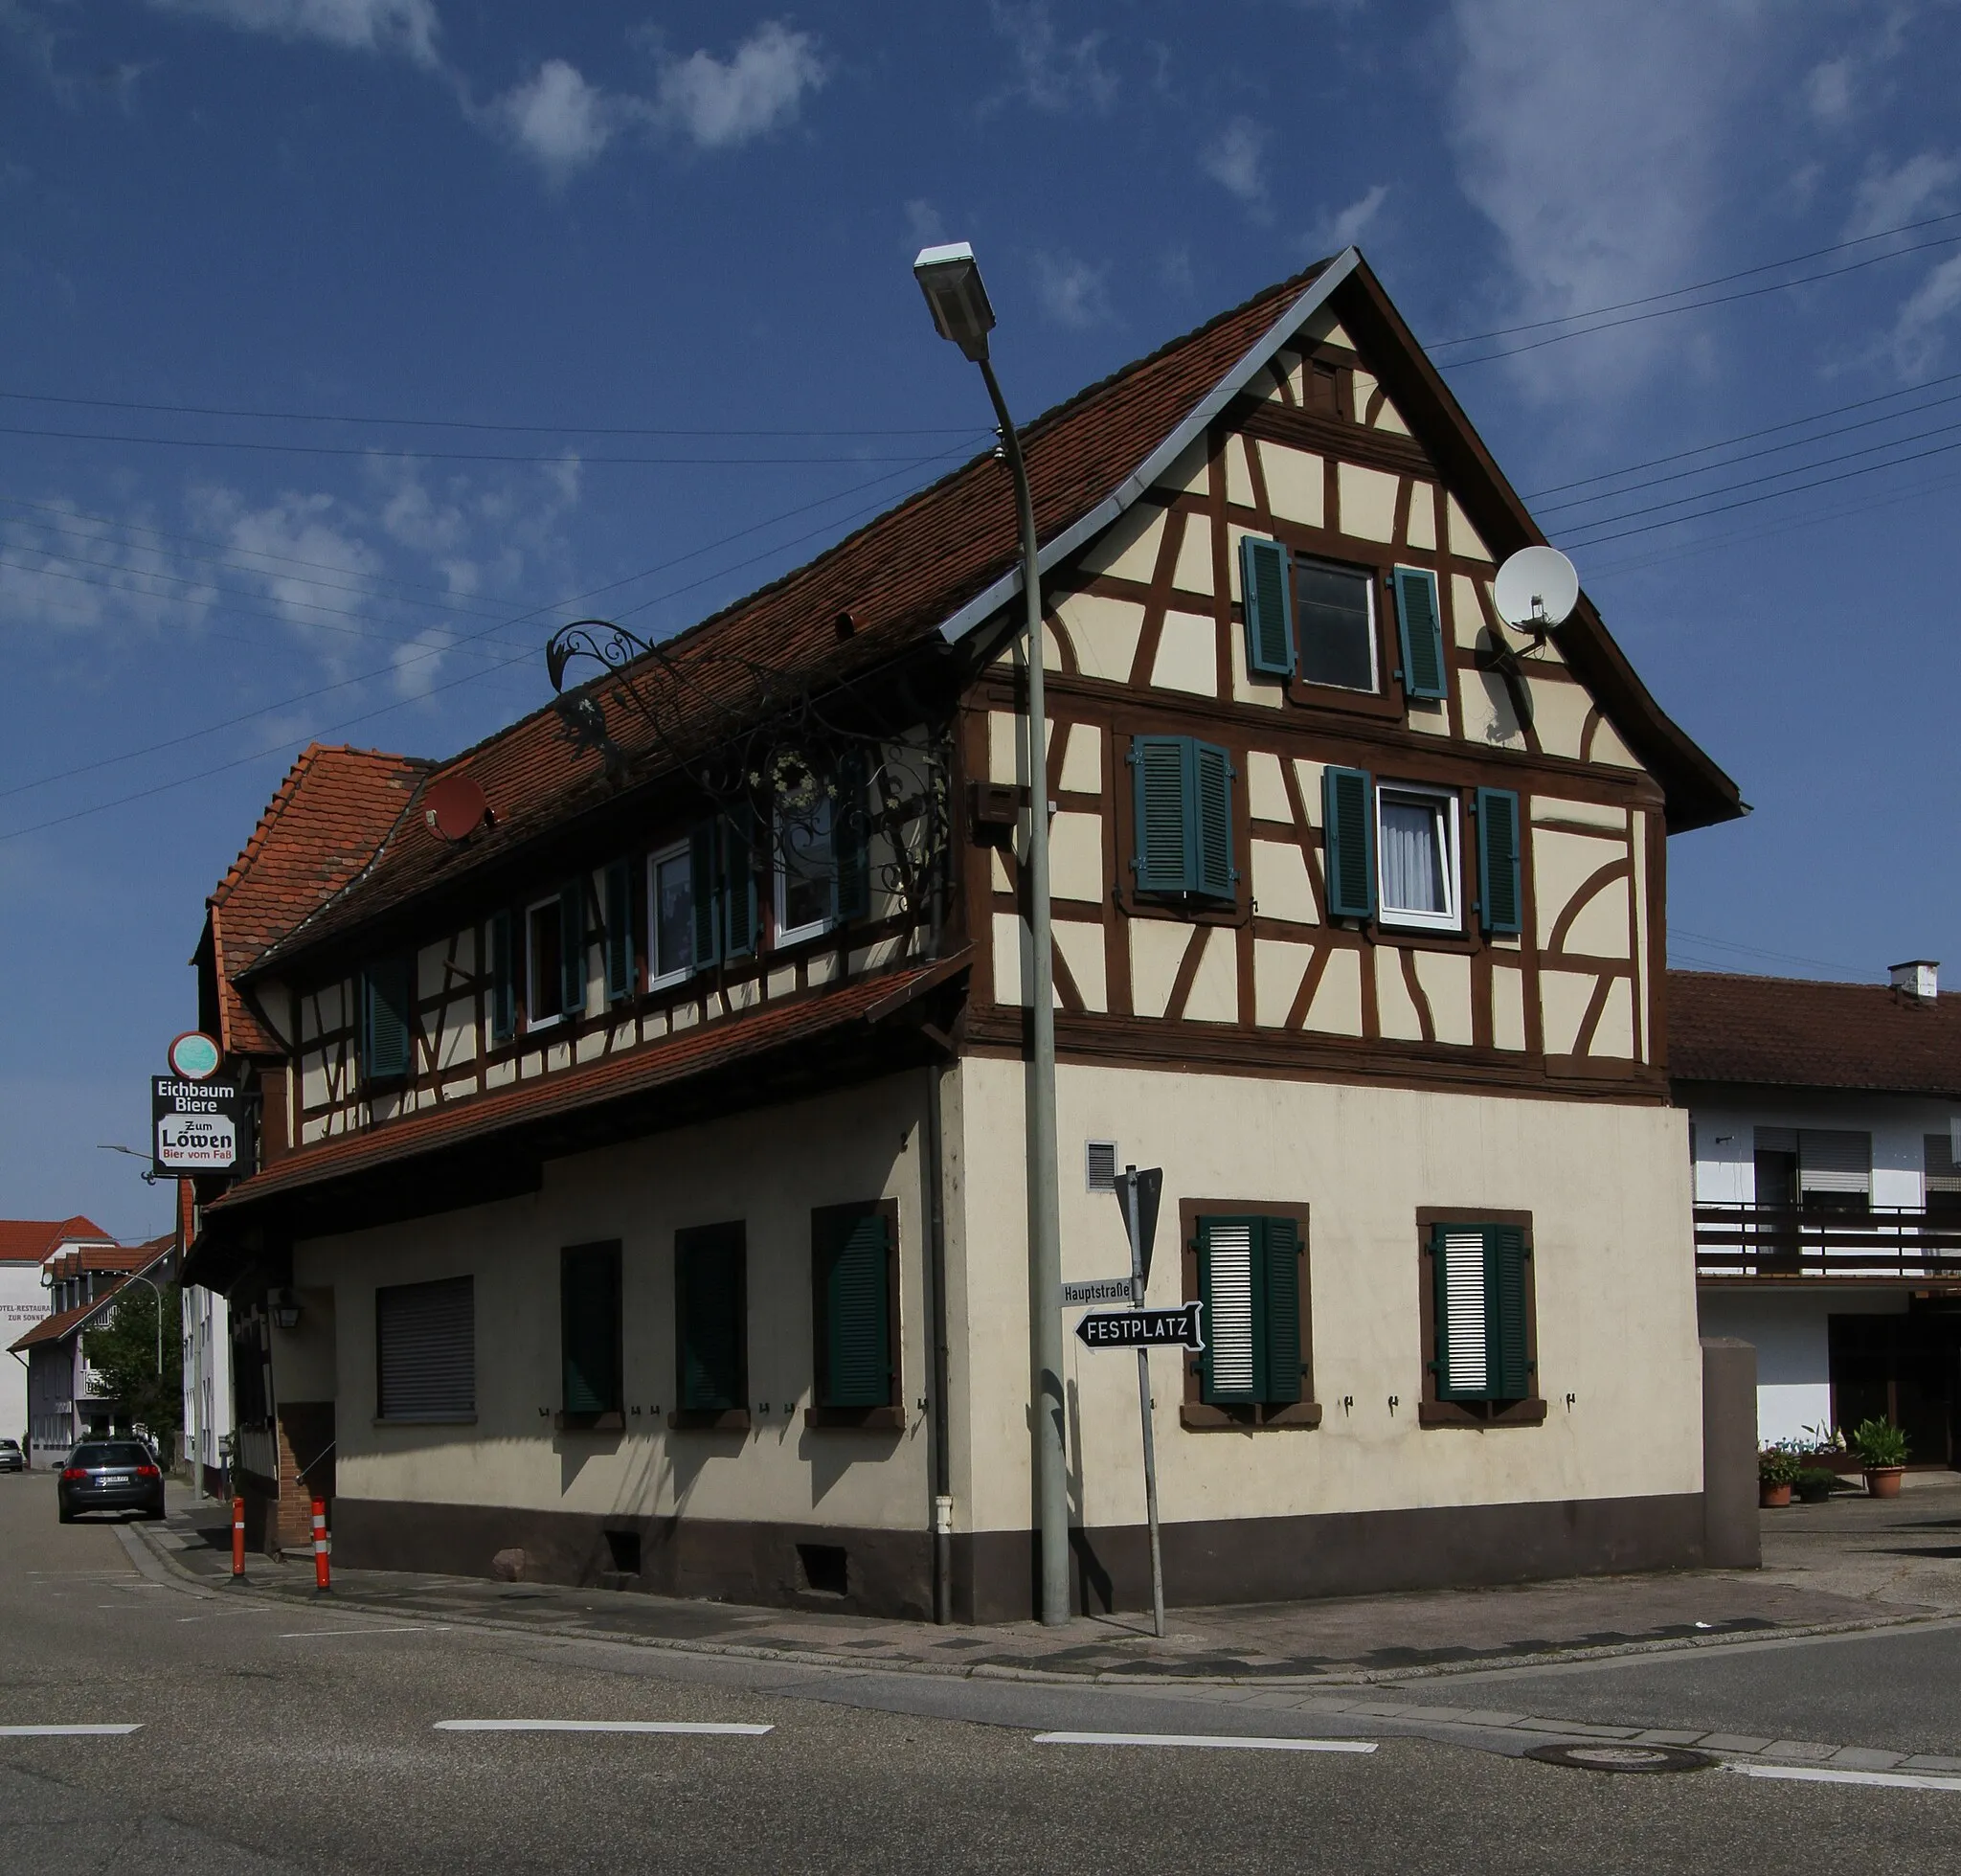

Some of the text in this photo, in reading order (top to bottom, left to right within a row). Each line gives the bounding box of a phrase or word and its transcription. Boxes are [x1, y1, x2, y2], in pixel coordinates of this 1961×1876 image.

[158, 1081, 235, 1098] Eichbaum
[175, 1096, 217, 1113] Biere
[185, 1120, 213, 1131] Zum
[162, 1129, 232, 1148] Löwen
[163, 1149, 184, 1159] Bier
[214, 1150, 232, 1159] Faß
[1065, 1282, 1130, 1303] Hauptstraße
[1087, 1317, 1188, 1340] FESTPLATZ
